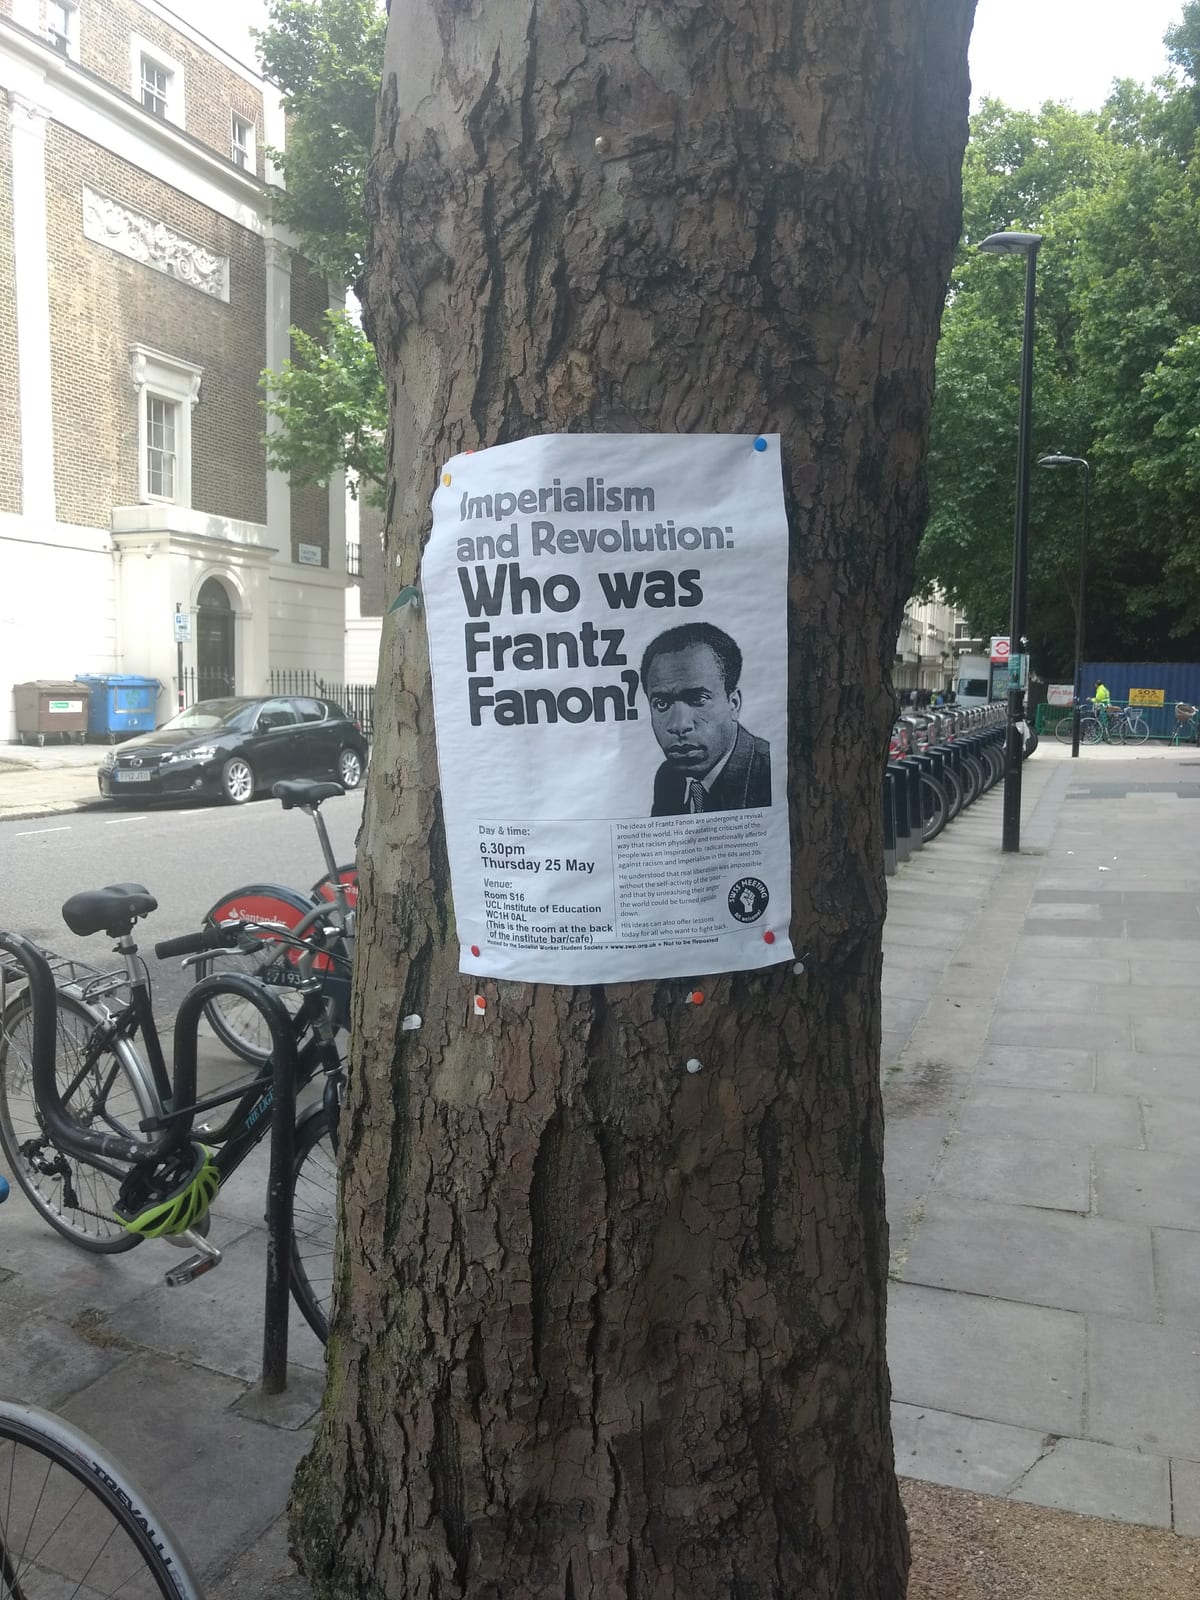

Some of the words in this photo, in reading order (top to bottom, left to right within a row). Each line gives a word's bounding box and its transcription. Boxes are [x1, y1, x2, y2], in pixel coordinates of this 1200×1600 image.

[460, 477, 655, 522] Imperialism
[457, 523, 519, 562] and
[532, 520, 734, 557] Revolution:
[457, 562, 580, 618] Who
[598, 568, 704, 610] was
[465, 622, 627, 672] Frantz
[468, 669, 640, 726] Fanon?
[479, 825, 495, 836] Day
[498, 826, 504, 835] &
[507, 827, 530, 836] time:
[685, 826, 717, 835] devastating
[668, 837, 697, 846] physically
[710, 832, 744, 841] emotionally
[480, 842, 525, 857] 6.30pm
[664, 847, 695, 856] inspiration
[481, 856, 540, 873] Thursday
[545, 859, 560, 871] 25
[566, 859, 594, 873] May
[678, 855, 710, 864] imperialism
[629, 871, 665, 879] understood
[693, 866, 718, 874] liberation
[484, 878, 512, 888] Venue:
[657, 878, 692, 887] self-activity
[484, 891, 507, 900] Room
[656, 888, 691, 897] unleashing
[729, 884, 741, 903] SWSS
[742, 880, 767, 898] MEETING
[700, 894, 716, 903] upside
[485, 900, 501, 909] UCL
[504, 903, 536, 912] Institute
[553, 905, 601, 913] Education
[486, 910, 509, 920] WC1H
[511, 913, 527, 922] 0AL
[486, 920, 505, 929] (This
[516, 923, 529, 932] the
[571, 924, 586, 932] the
[590, 924, 613, 932] back
[499, 931, 510, 940] the
[512, 933, 548, 943] institute
[551, 935, 593, 944] bar/cafe)
